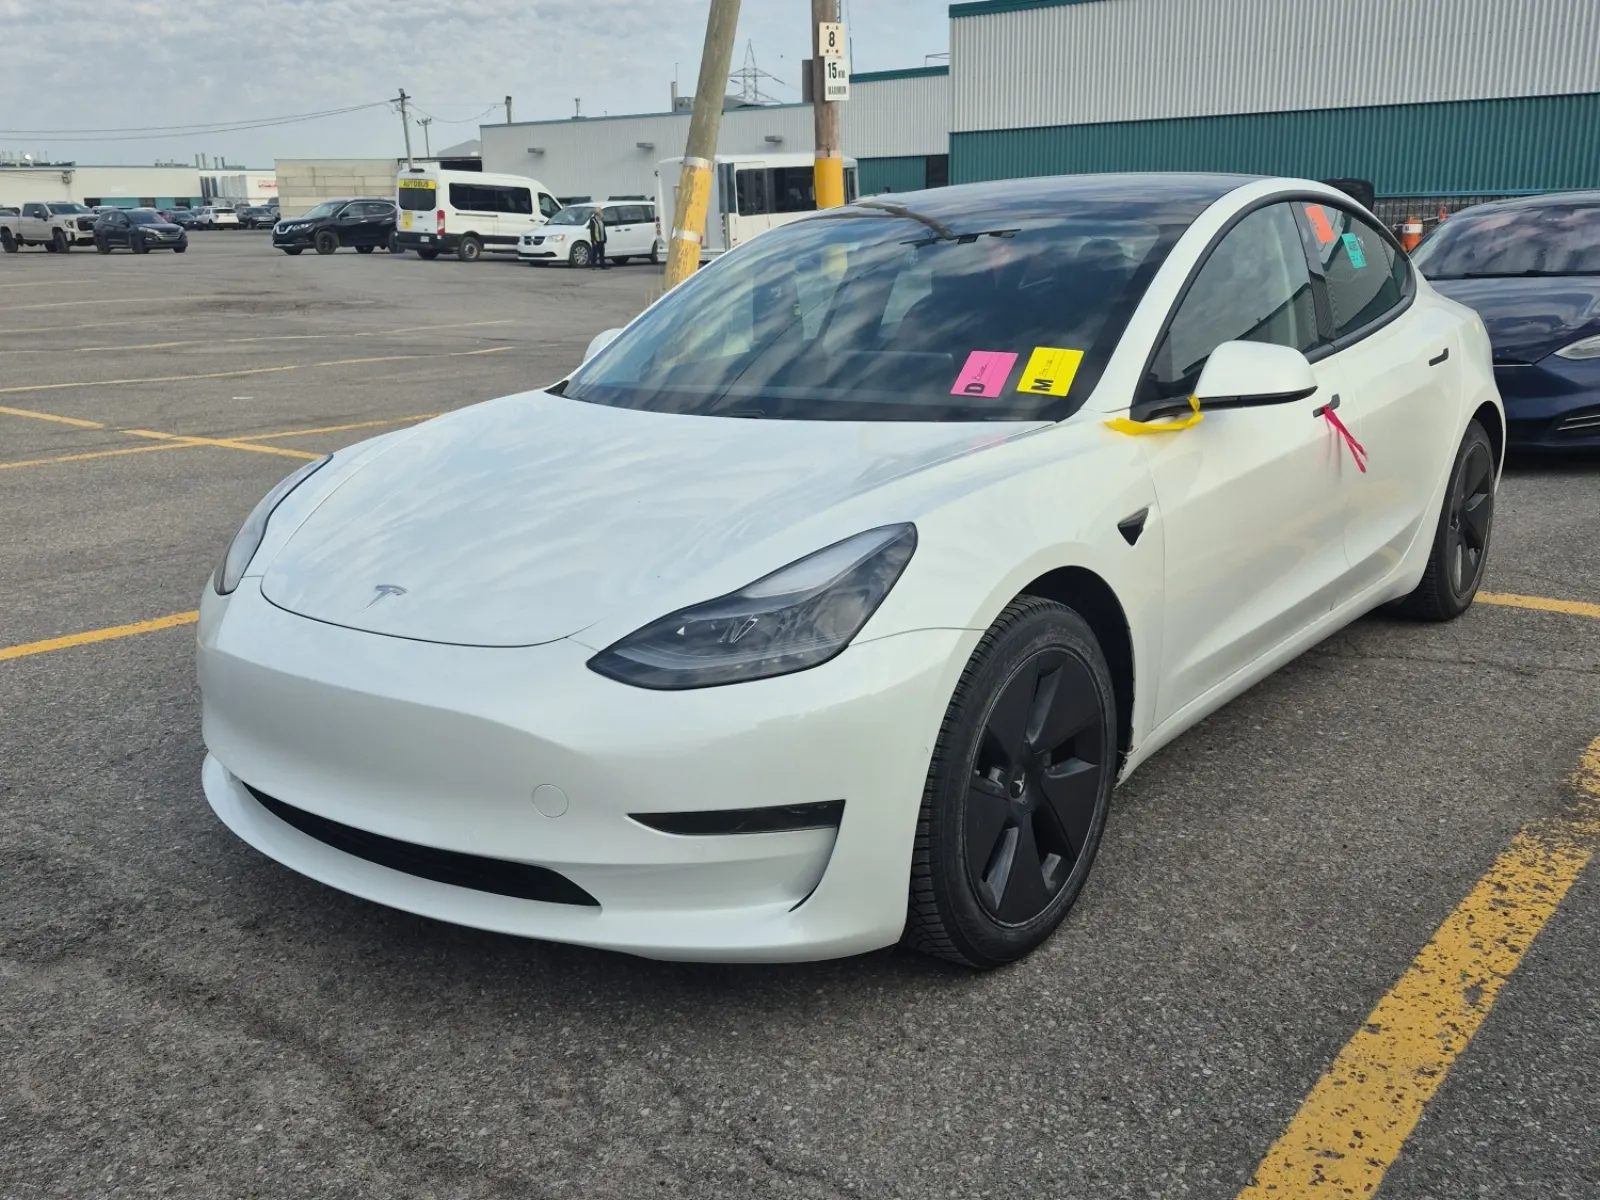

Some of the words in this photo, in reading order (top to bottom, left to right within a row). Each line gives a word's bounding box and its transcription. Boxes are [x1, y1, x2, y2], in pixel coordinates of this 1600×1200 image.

[828, 31, 835, 47] 8
[828, 62, 837, 79] 15
[403, 180, 430, 188] AUTOBUS
[963, 382, 986, 394] D
[1031, 378, 1054, 392] M
